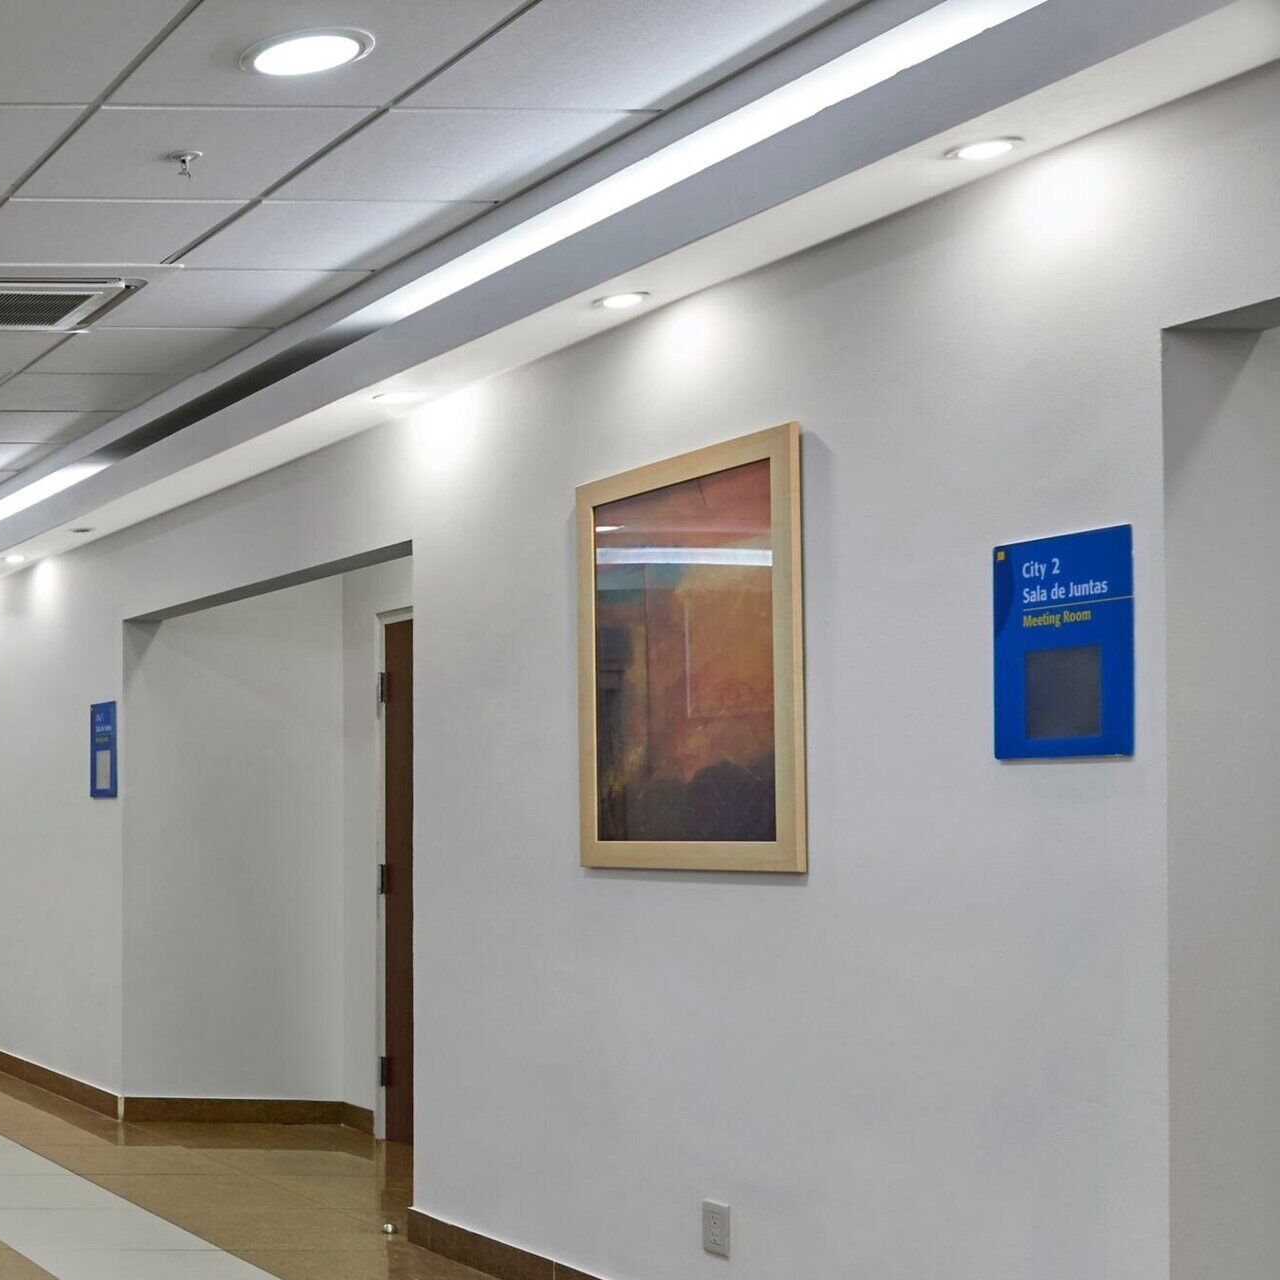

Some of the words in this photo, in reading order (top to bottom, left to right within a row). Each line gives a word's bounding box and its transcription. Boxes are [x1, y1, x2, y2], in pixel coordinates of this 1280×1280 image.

[1022, 561, 1047, 580] City
[1051, 557, 1060, 575] 2
[1023, 585, 1047, 603] Sala
[1051, 582, 1066, 600] de
[1069, 579, 1108, 598] Juntas
[1023, 611, 1061, 628] Meeting
[1063, 610, 1092, 623] Room
